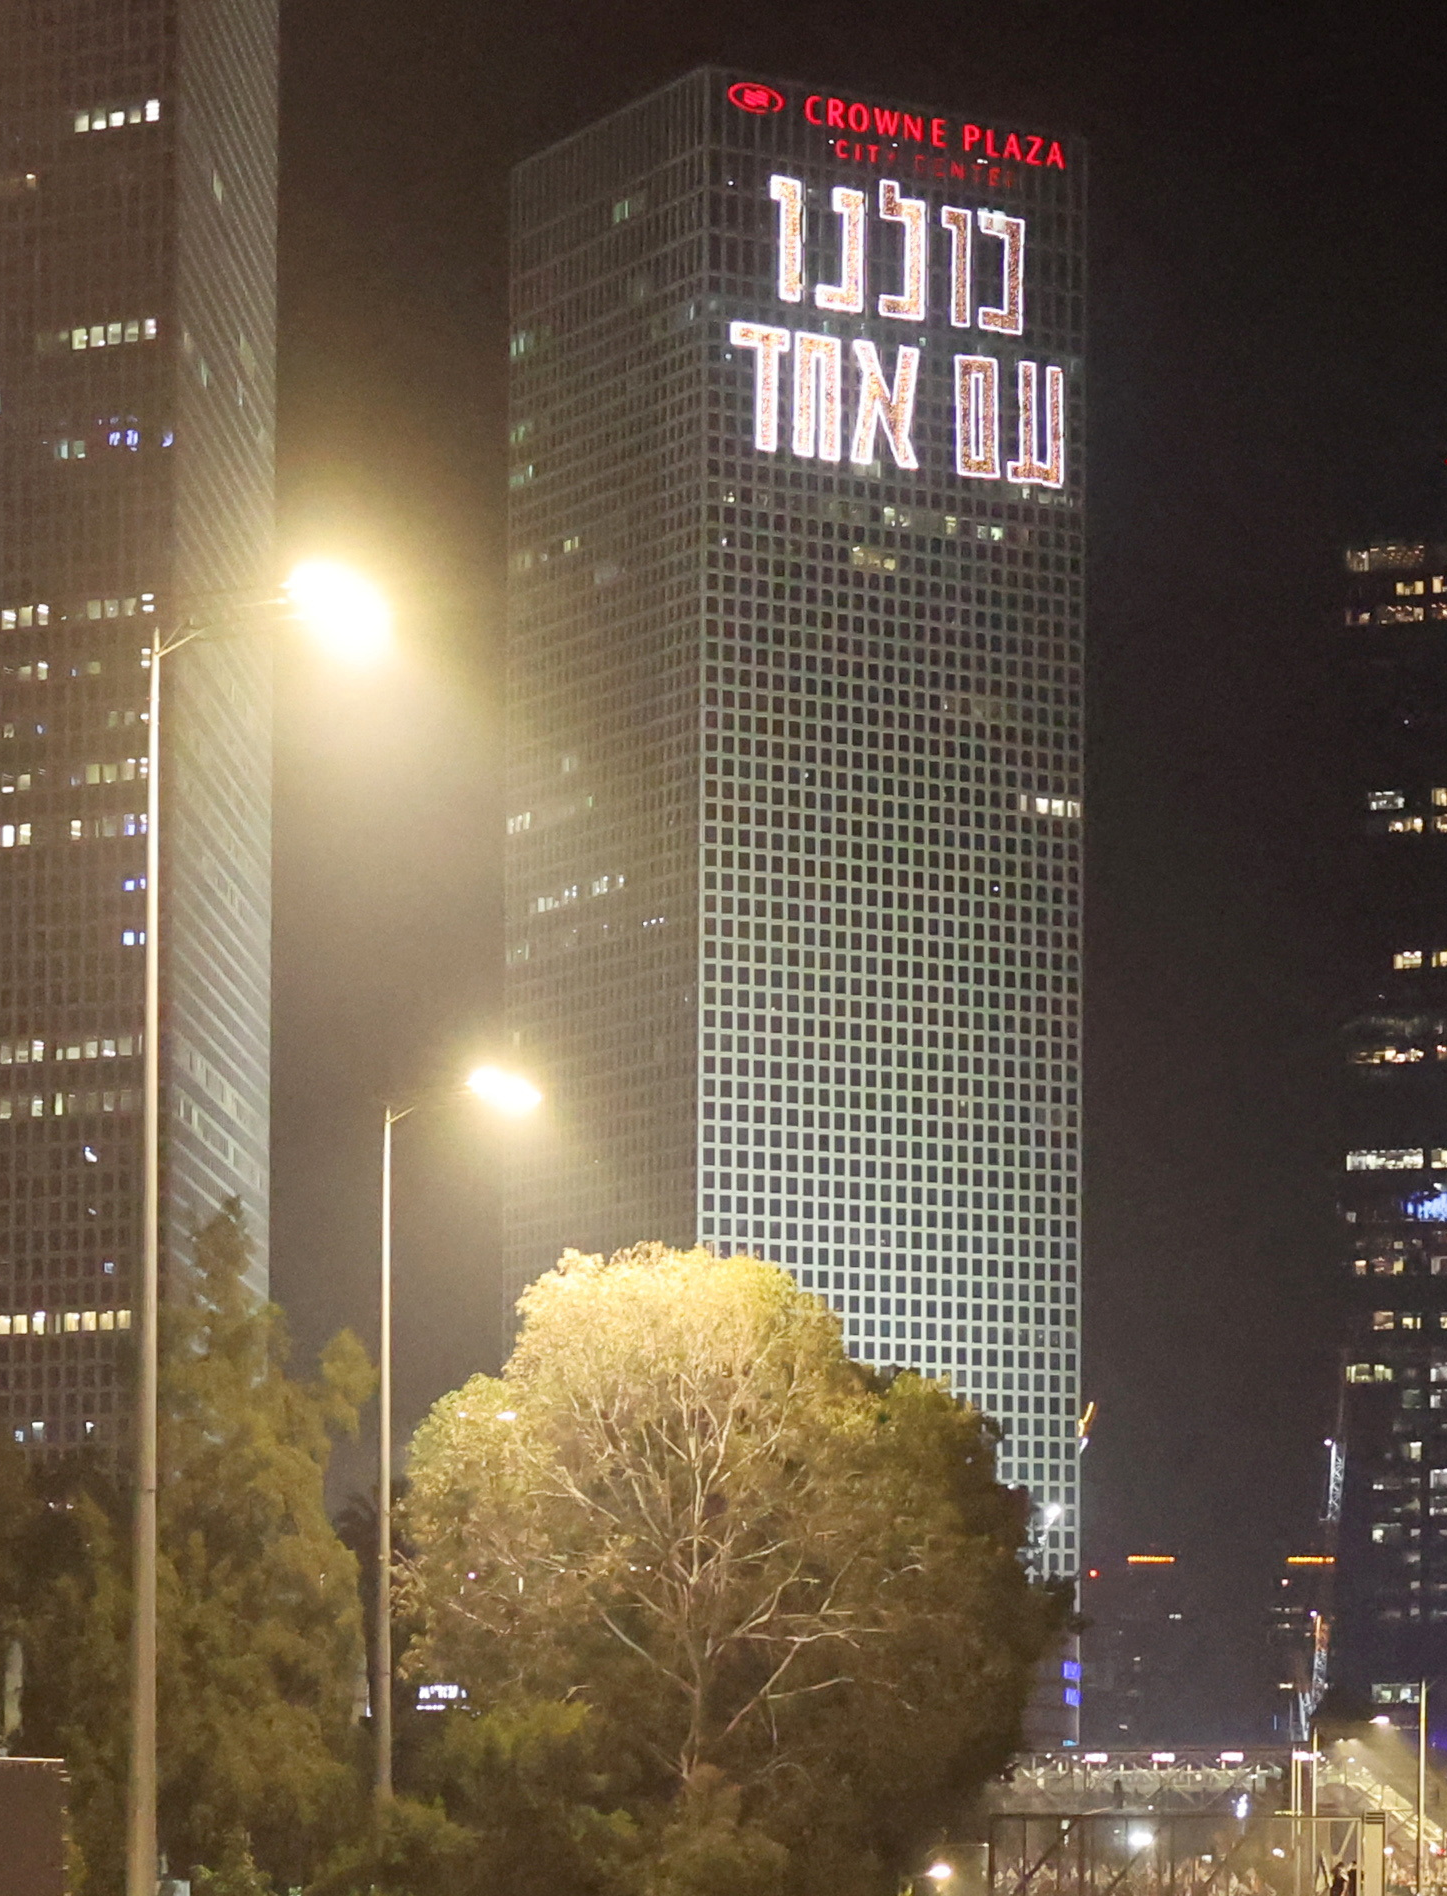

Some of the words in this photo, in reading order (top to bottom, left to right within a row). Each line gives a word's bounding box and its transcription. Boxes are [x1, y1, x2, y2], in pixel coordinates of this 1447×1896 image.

[804, 95, 947, 148] CROWNE
[963, 125, 1066, 169] PLAZA
[770, 174, 1026, 335] כולנו
[729, 321, 921, 470] אחד
[954, 354, 1065, 488] עם
